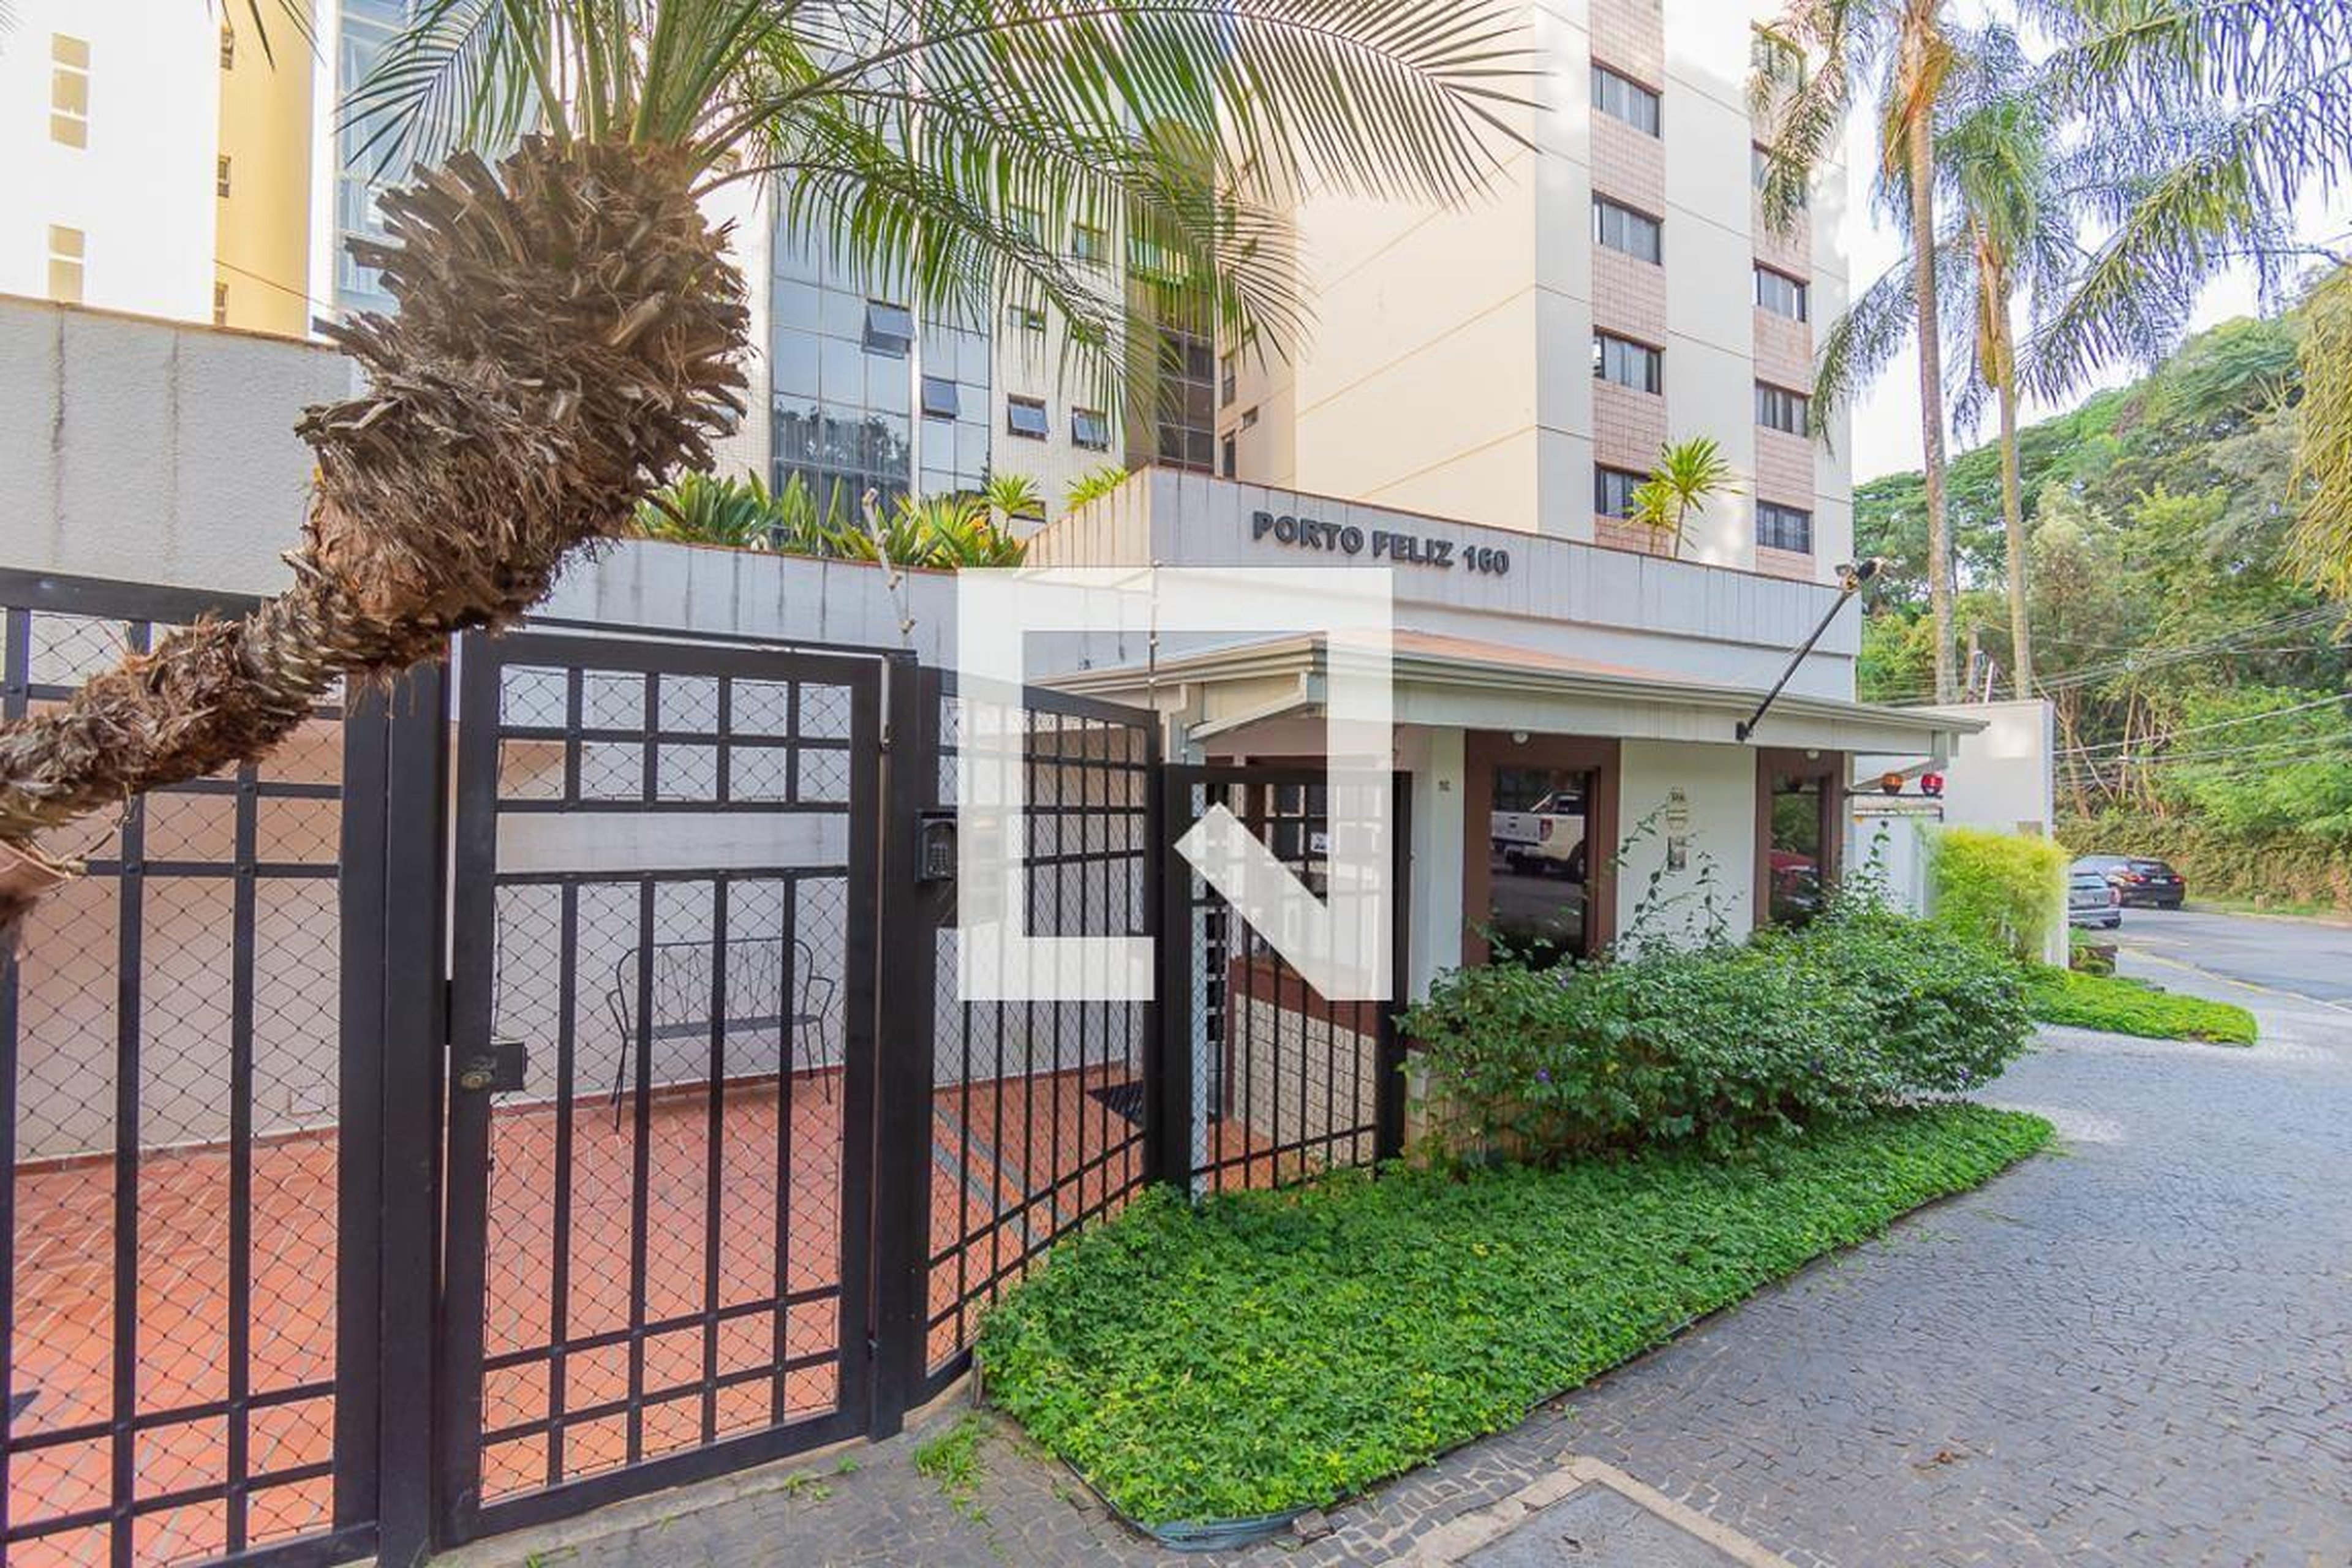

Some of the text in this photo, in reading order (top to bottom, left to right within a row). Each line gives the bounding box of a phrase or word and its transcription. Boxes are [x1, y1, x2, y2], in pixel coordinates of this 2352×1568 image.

[1253, 511, 1509, 574] PORTO FELIZ 160
